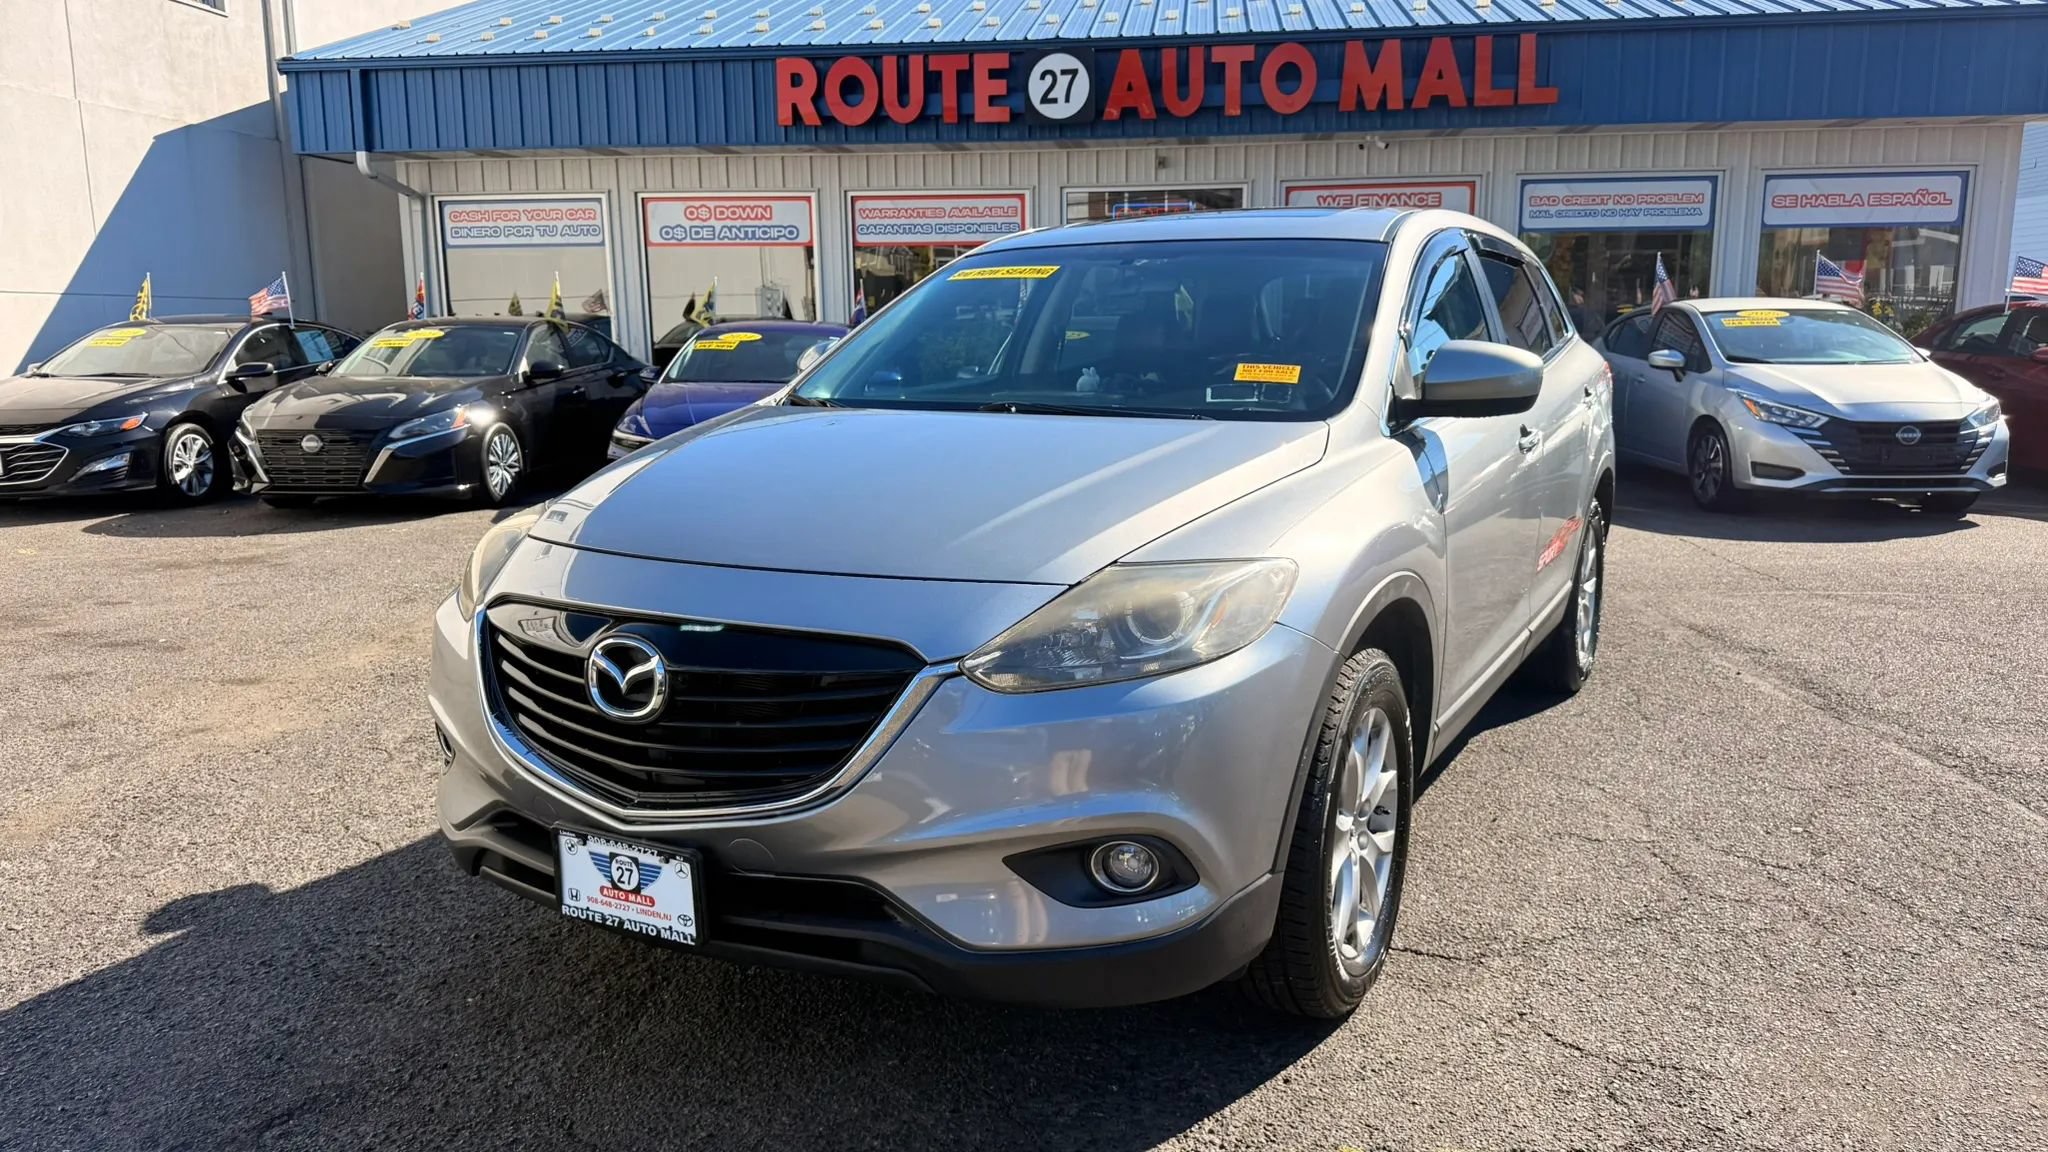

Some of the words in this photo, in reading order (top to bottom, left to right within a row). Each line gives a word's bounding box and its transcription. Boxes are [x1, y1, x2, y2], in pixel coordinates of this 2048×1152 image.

[776, 52, 1010, 126] ROUTE
[1038, 68, 1079, 105] 27
[1102, 42, 1318, 121] AUTO
[1338, 32, 1559, 112] MALL
[1317, 194, 1353, 209] WE
[1356, 192, 1441, 208] FINANCE
[1529, 195, 1559, 207] BAD
[1562, 194, 1611, 206] CREDIT
[1614, 194, 1634, 206] NO
[1637, 193, 1704, 206] PROBLEM
[1772, 195, 1798, 208] SE
[1800, 193, 1865, 207] HABLA
[1867, 188, 1952, 207] ESPAÑOL
[450, 210, 490, 222] CASH
[492, 209, 520, 222] FOR
[523, 209, 562, 221] YOUR
[565, 208, 596, 221] CAR
[715, 205, 772, 220] DOWN
[859, 207, 945, 219] WARRANTIES
[948, 206, 1017, 218] AVAILABLE
[1529, 209, 1553, 218] MAL
[1554, 208, 1600, 218] CREDITO
[1601, 208, 1617, 217] NO
[1618, 208, 1642, 217] HAY
[1643, 207, 1702, 217] PROBLEMA
[450, 226, 501, 238] DINERO
[503, 225, 533, 237] POR
[536, 225, 558, 237] TU
[560, 224, 601, 237] AUTO
[689, 225, 715, 241] DE
[718, 225, 799, 241] ANTICIPO
[857, 224, 934, 235] GARANTIAS
[935, 223, 1019, 234] DISPONIBLES
[615, 858, 634, 868] ROUTE
[616, 866, 634, 886] 27
[587, 895, 630, 912] 908-648-2727
[602, 887, 626, 900] AUTO
[628, 894, 653, 906] MALL
[562, 904, 603, 924] ROUTE
[605, 915, 620, 927] 27
[623, 920, 657, 936] AUTO
[660, 927, 696, 946] MALL
